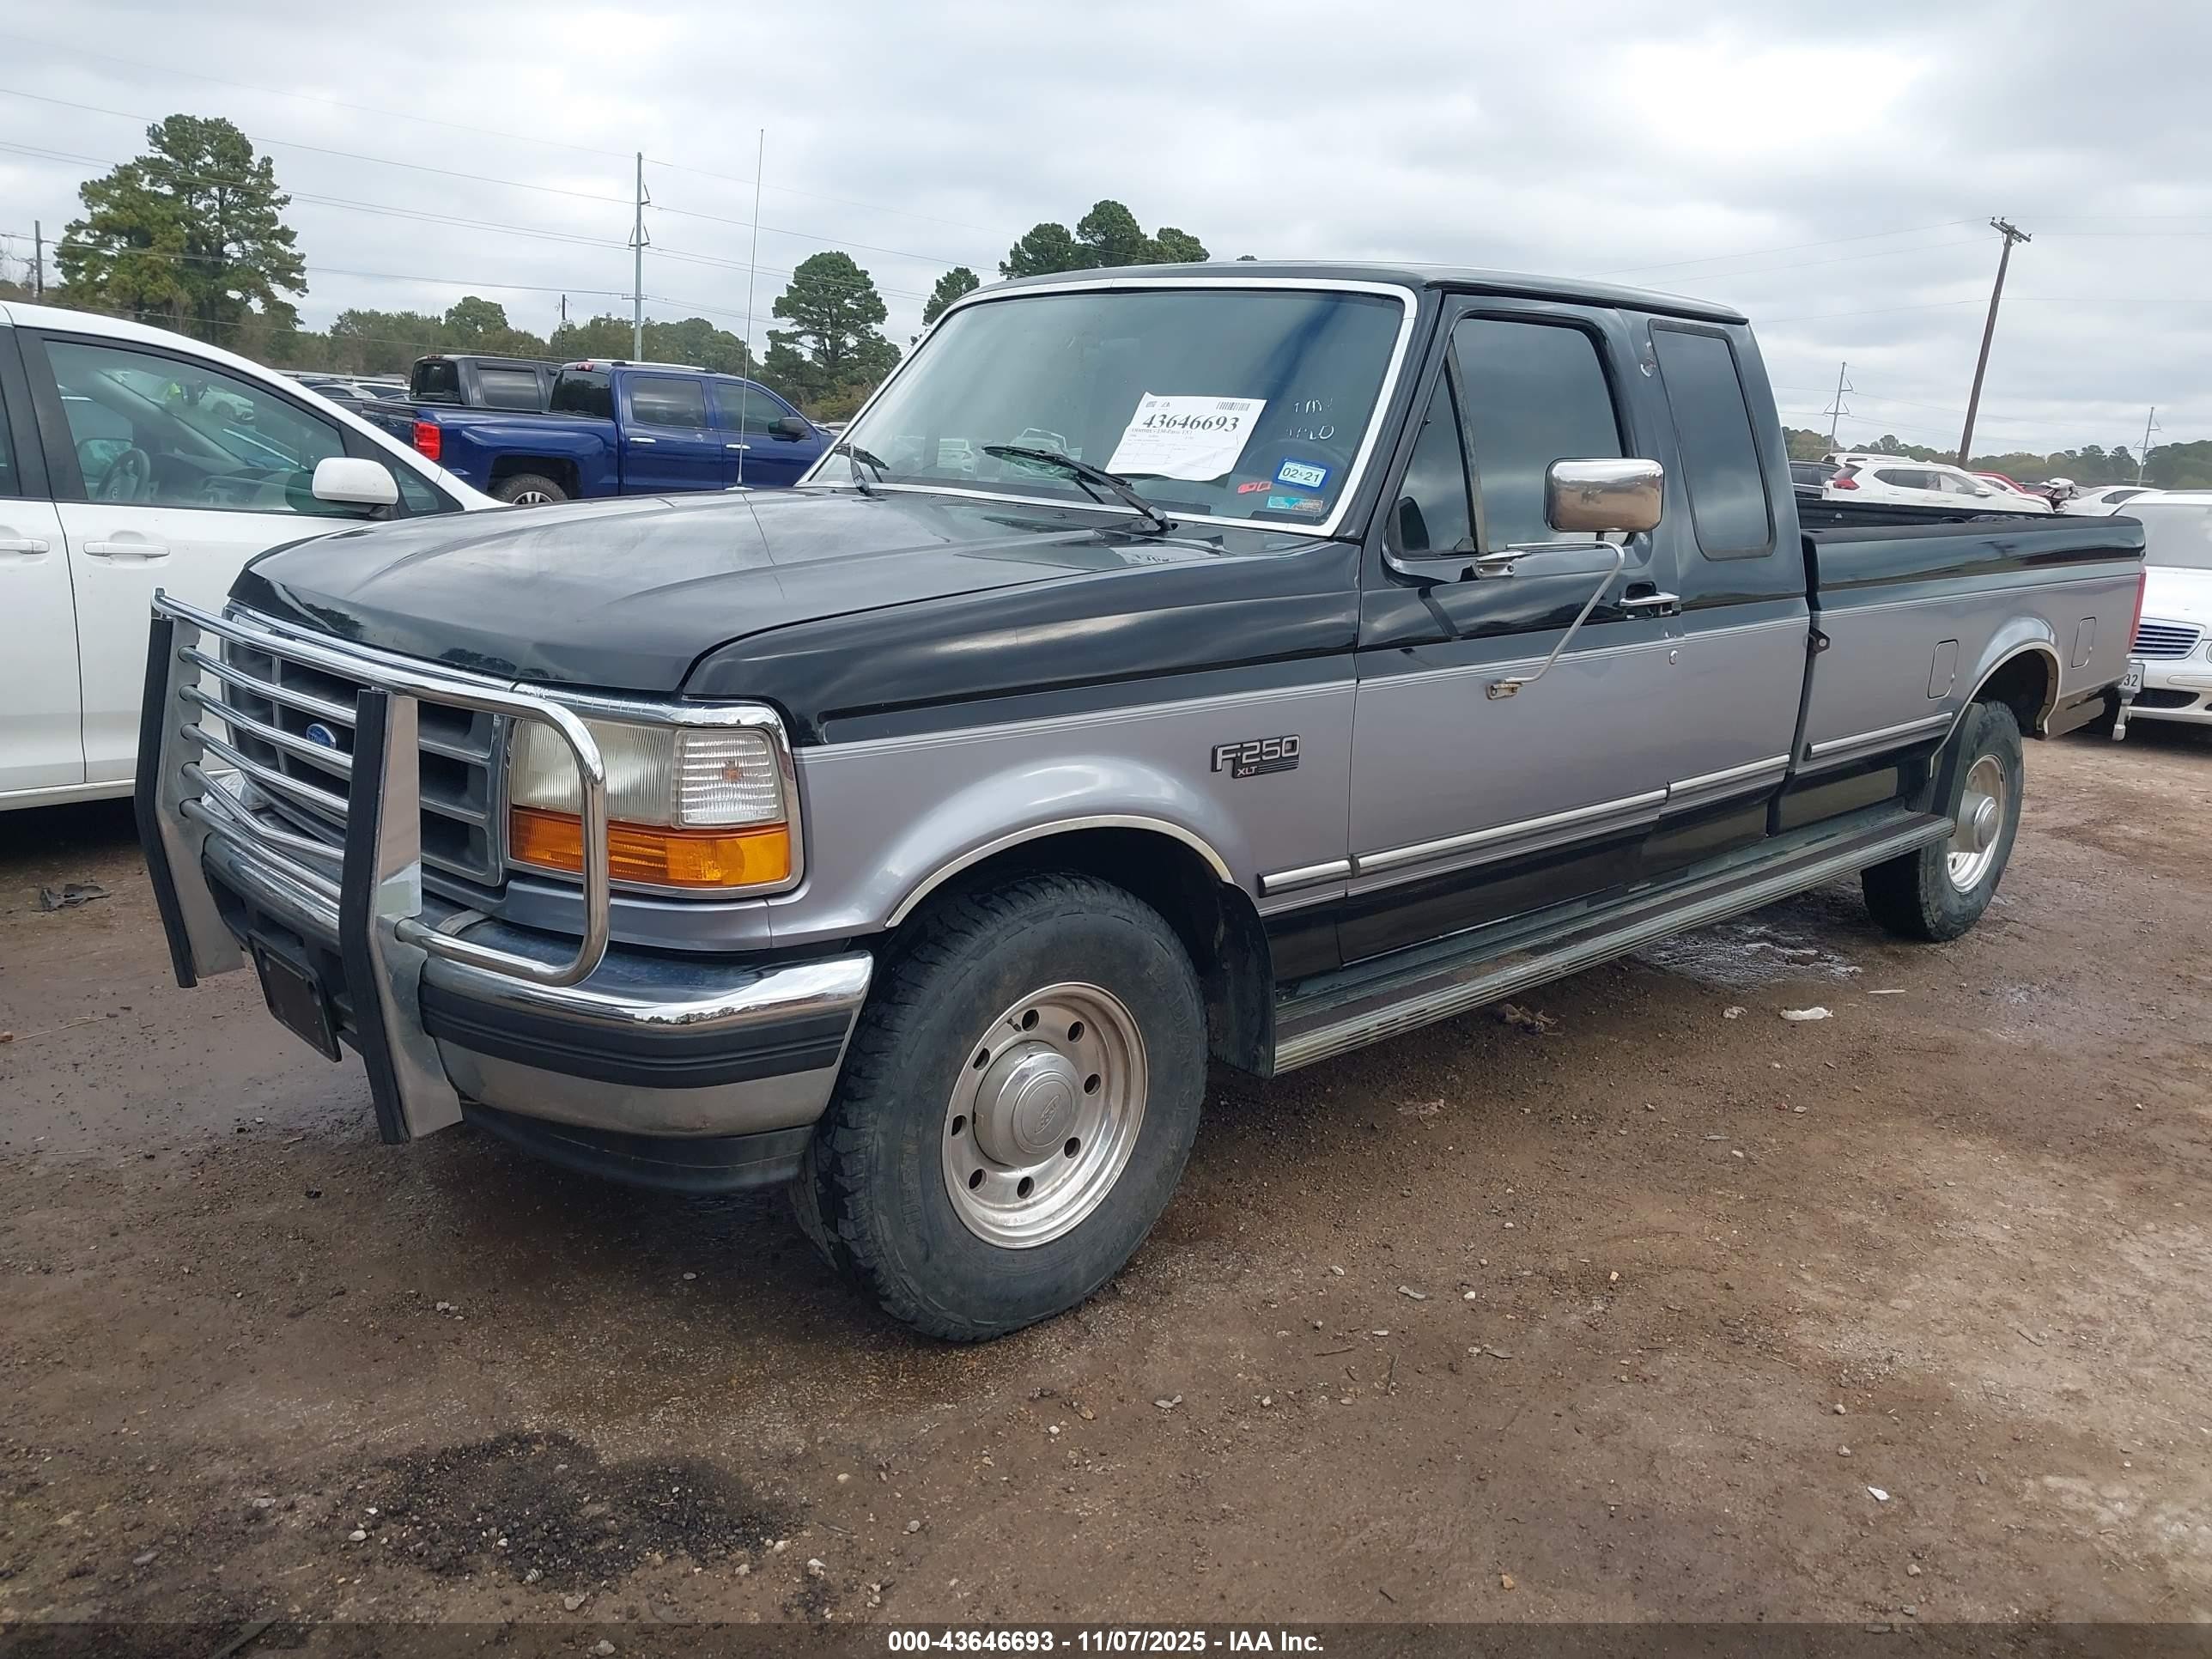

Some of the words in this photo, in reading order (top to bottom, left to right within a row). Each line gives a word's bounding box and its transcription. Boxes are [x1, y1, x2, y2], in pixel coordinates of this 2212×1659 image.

[1142, 413, 1240, 433] 43646693
[1282, 467, 1299, 478] 02
[1303, 471, 1321, 483] 21
[1237, 766, 1258, 777] XLT
